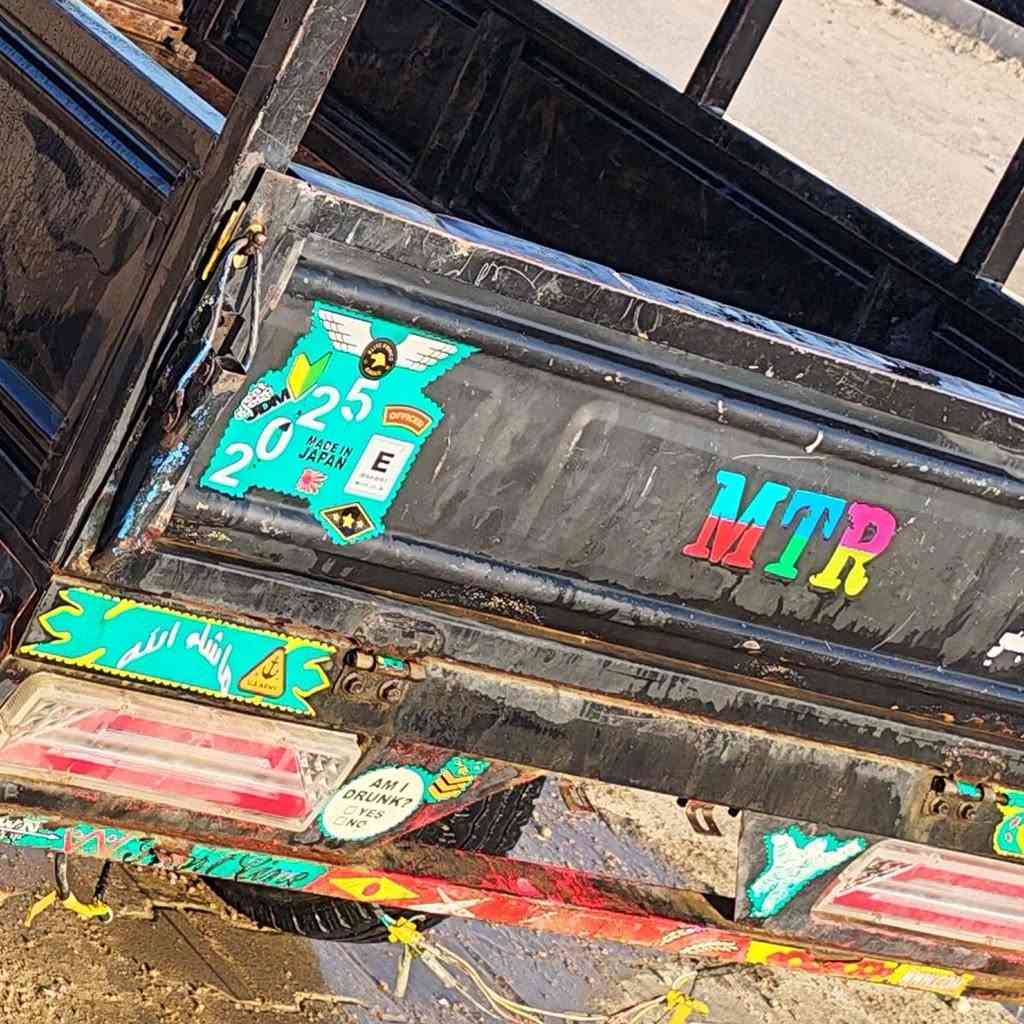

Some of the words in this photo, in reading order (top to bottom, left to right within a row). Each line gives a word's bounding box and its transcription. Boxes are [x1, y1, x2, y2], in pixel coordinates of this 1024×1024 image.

[307, 435, 339, 453] MADE
[339, 443, 353, 457] IN
[298, 447, 349, 470] JAPAN
[371, 451, 395, 473] E
[682, 469, 897, 598] MTR
[369, 778, 398, 791] AM
[400, 782, 409, 793] I
[342, 789, 413, 808] DRUNK?
[359, 808, 386, 819] YES
